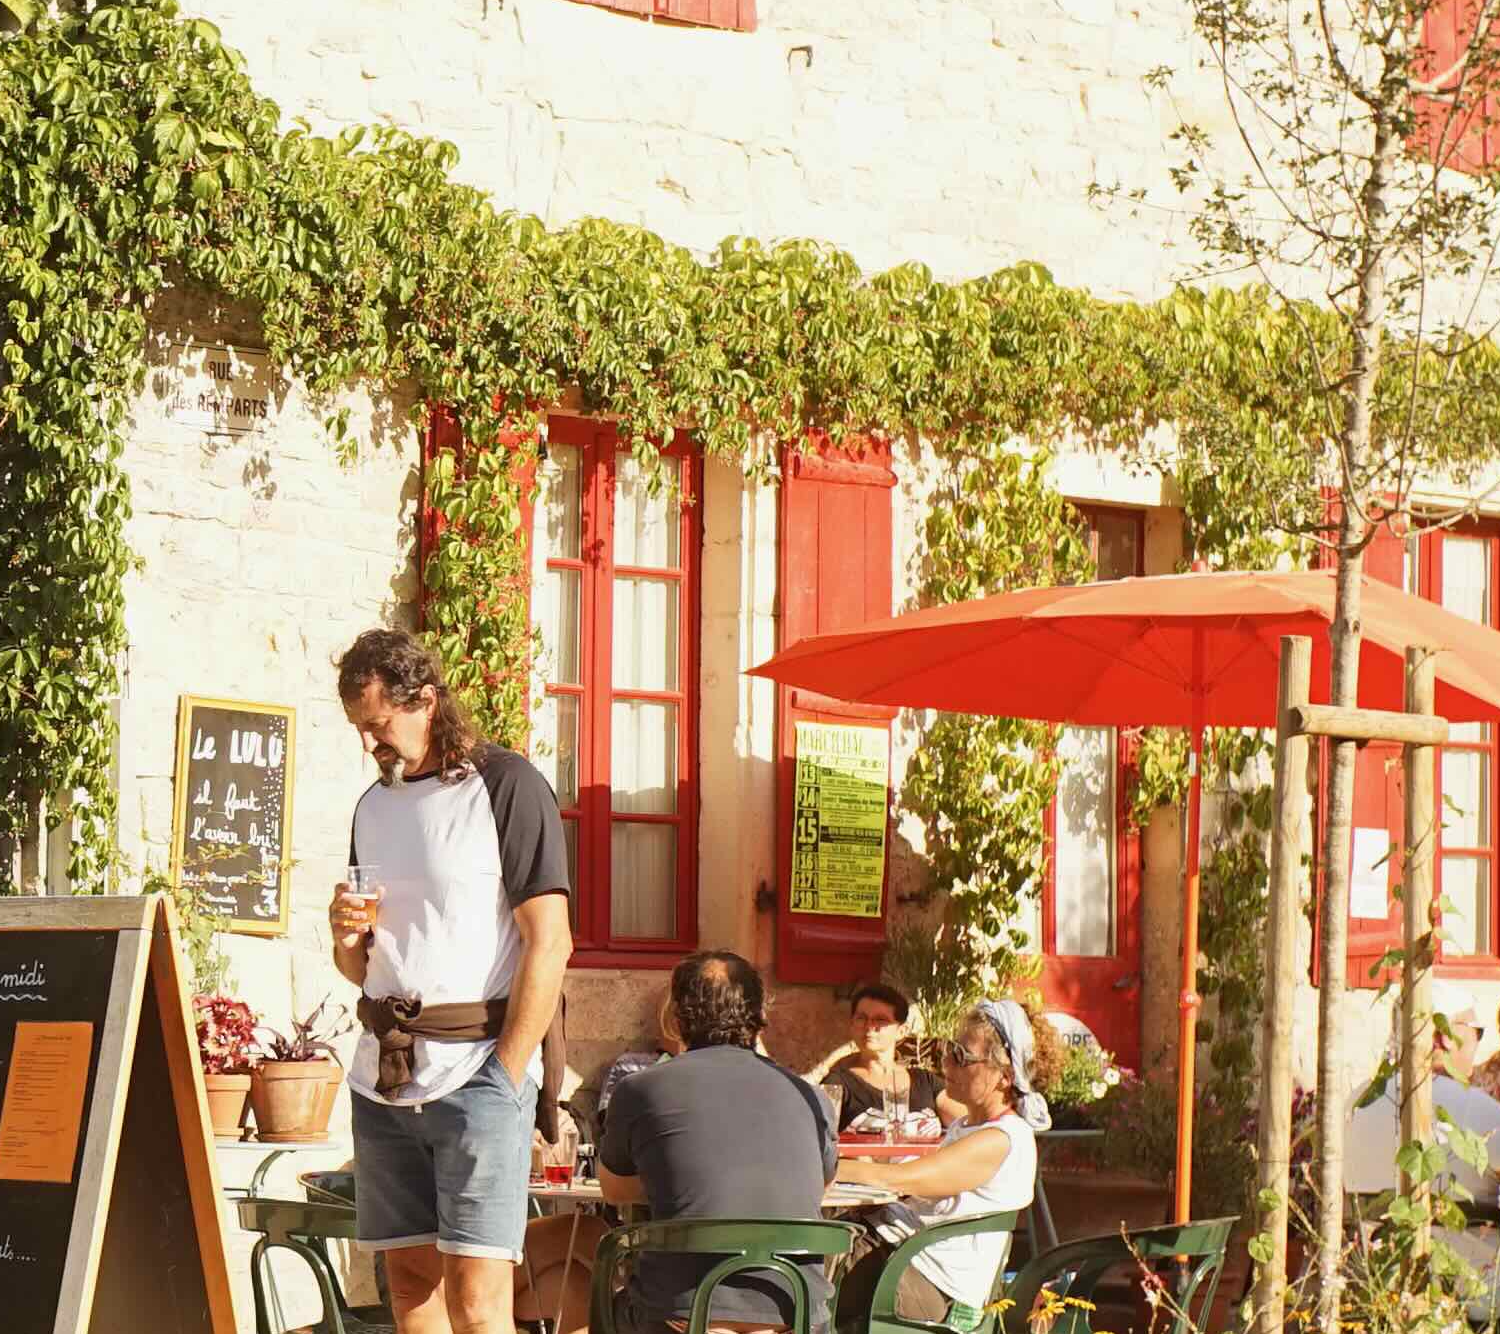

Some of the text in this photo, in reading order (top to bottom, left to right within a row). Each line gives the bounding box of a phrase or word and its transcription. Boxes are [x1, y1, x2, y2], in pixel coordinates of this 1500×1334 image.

[192, 728, 283, 768] Le LULU
[193, 779, 262, 821] il faut
[799, 817, 817, 844] 15
[0, 961, 46, 987] midi
